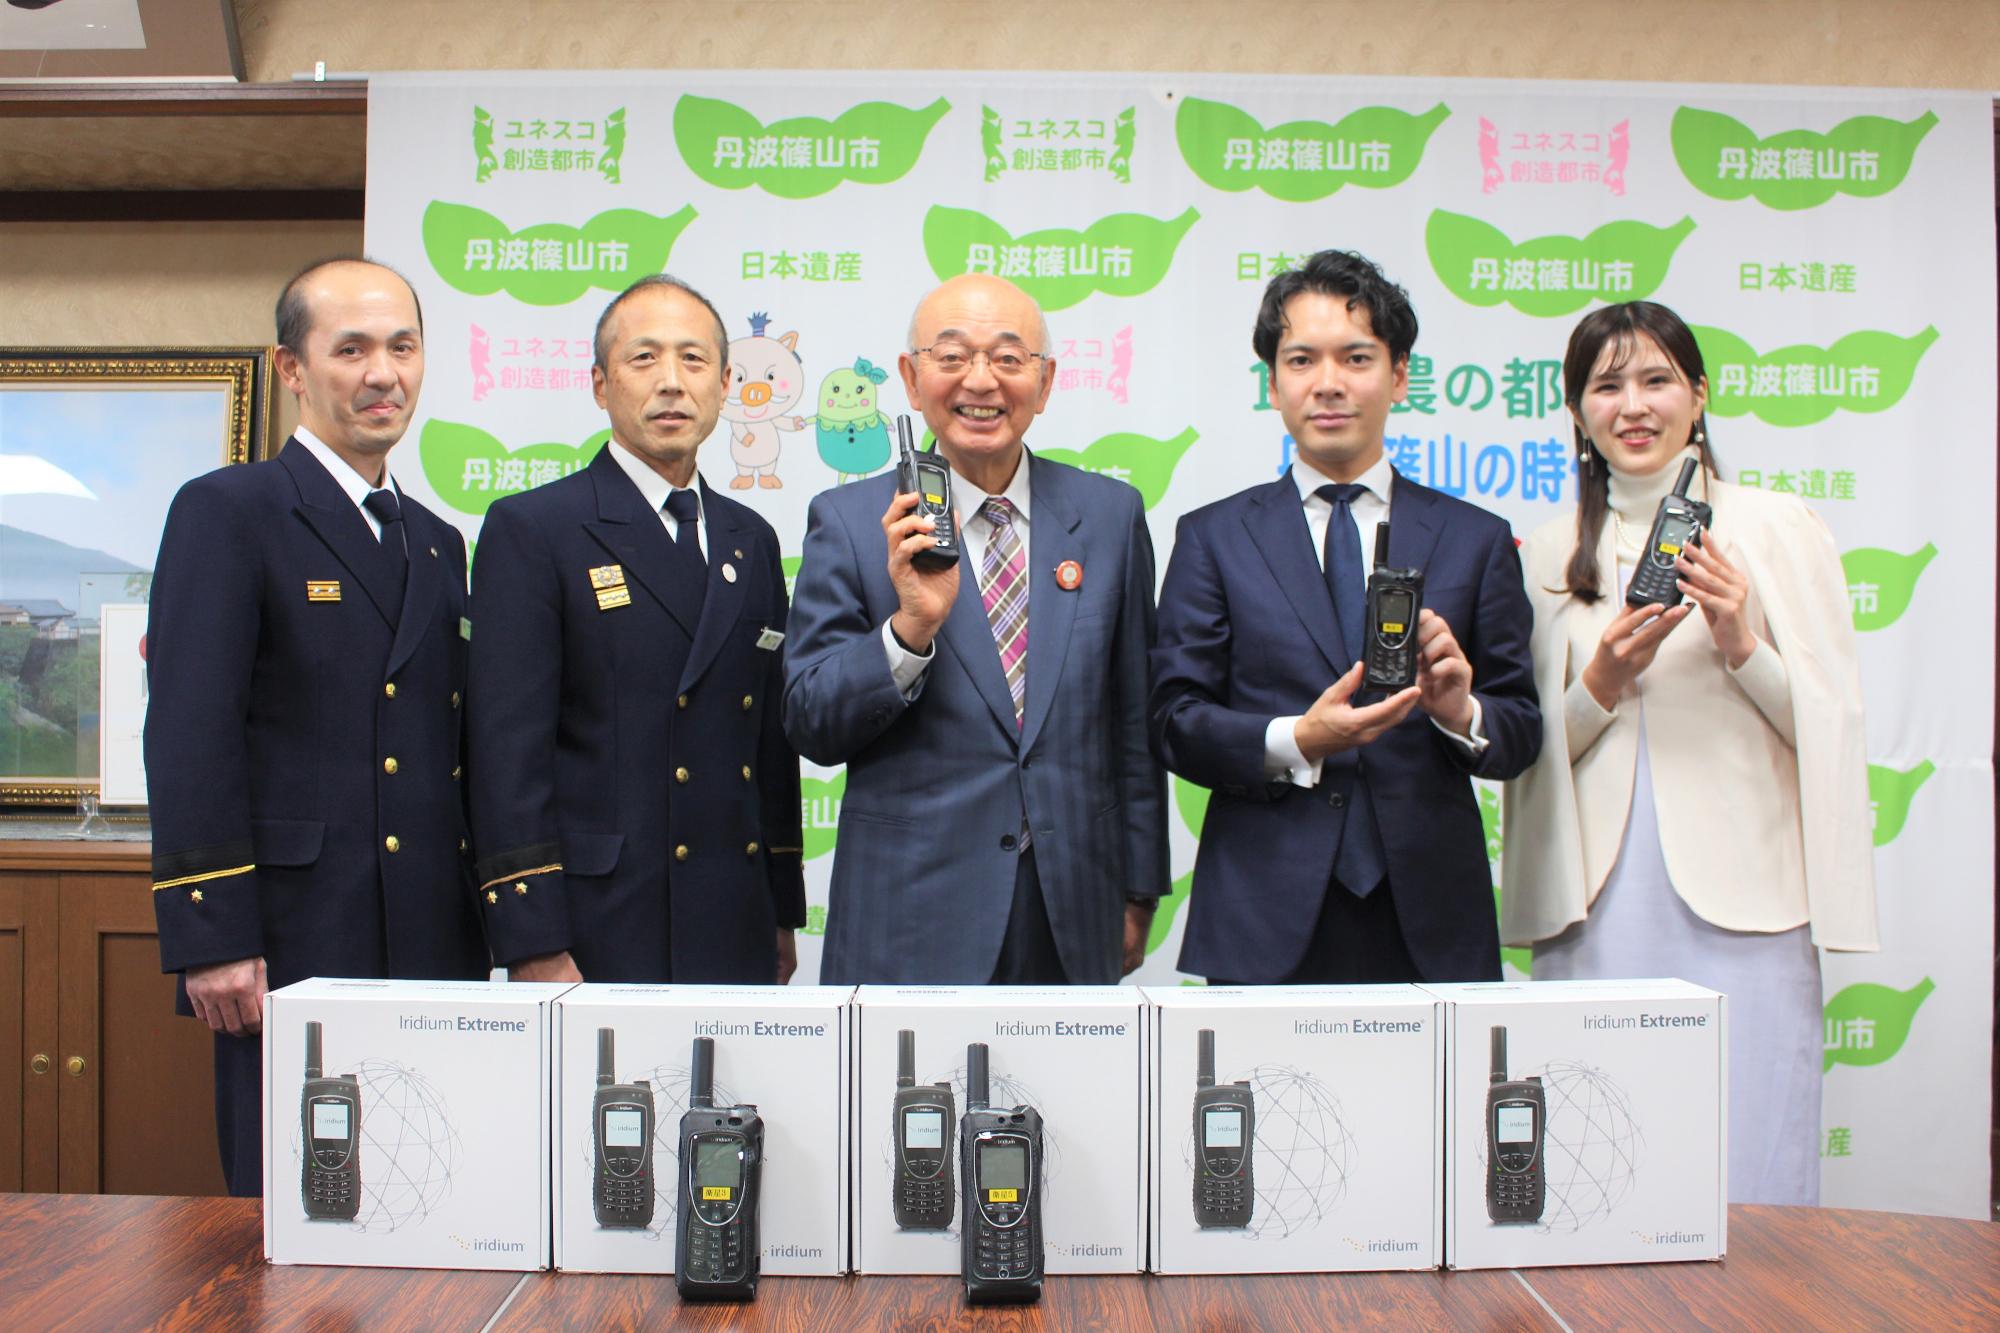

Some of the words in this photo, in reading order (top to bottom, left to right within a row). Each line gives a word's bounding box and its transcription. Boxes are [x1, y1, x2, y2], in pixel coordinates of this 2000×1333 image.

[505, 119, 595, 141] ユネスコ
[1013, 119, 1105, 141] ユネスコ
[713, 135, 881, 169] 丹波篠山市
[1510, 131, 1600, 153] ユネスコ
[503, 148, 595, 173] 創造都市
[1012, 148, 1106, 173] 創造都市
[1223, 138, 1391, 172] 丹波篠山市
[1717, 146, 1879, 181] 丹波篠山市
[1509, 160, 1600, 185] 創造都市
[464, 238, 629, 273] 丹波篠山市
[741, 249, 862, 281] 日本遺産
[965, 242, 1133, 279] 丹波篠山市
[1237, 251, 1309, 281] 日本
[1469, 258, 1633, 292] 丹波篠山市
[1739, 262, 1857, 293] 日本遺産
[501, 337, 592, 359] ユネスコ
[500, 366, 592, 391] 創造都市
[1717, 363, 1880, 398] 丹波篠山市
[399, 1015, 453, 1032] Iridium
[694, 1019, 750, 1036] Iridium
[995, 1020, 1051, 1037] Iridium
[1294, 1019, 1349, 1034] Iridium
[1584, 1014, 1636, 1030] Iridium
[474, 1239, 524, 1252] iridium
[1368, 1239, 1419, 1252] iridium
[1655, 1231, 1704, 1244] iridium
[771, 1244, 822, 1258] iridium
[1071, 1243, 1123, 1257] iridium
